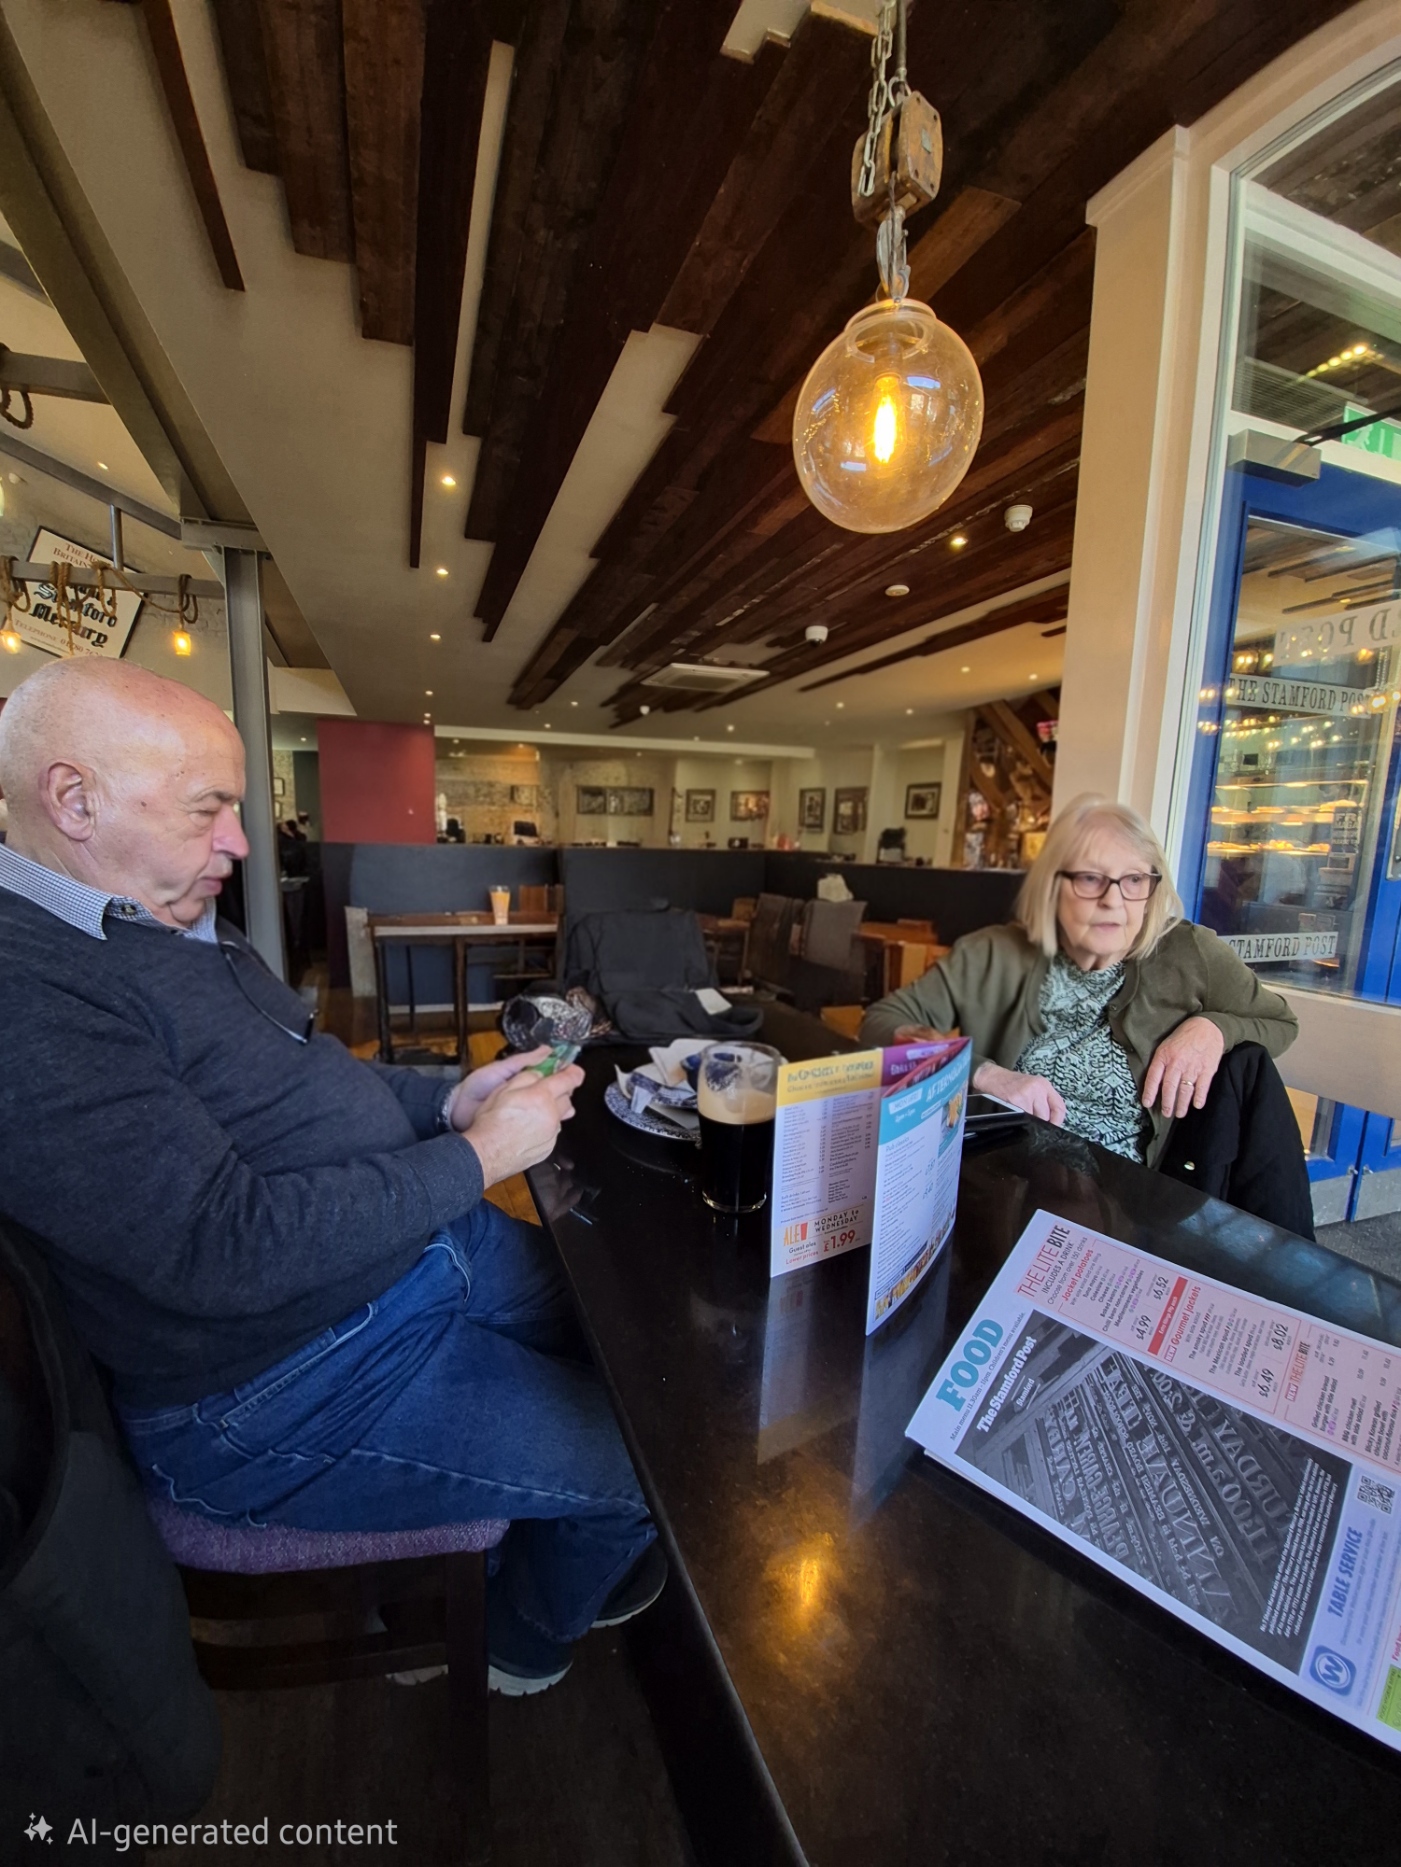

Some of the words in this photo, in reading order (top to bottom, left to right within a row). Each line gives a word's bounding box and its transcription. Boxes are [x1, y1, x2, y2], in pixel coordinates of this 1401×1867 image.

[33, 583, 117, 627] Stford
[29, 603, 109, 648] Meury
[1229, 677, 1257, 703] THE
[1262, 681, 1336, 711] STAMFORD
[1303, 935, 1336, 956] POST
[814, 1211, 847, 1227] MONDAY
[815, 1214, 857, 1233] WEDNESDAY
[783, 1223, 800, 1246] ALE
[788, 1243, 804, 1254] Guest
[823, 1228, 856, 1252] £1.99
[785, 1253, 802, 1265] Lower
[802, 1248, 818, 1260] prices
[1016, 1269, 1045, 1299] THE
[1031, 1244, 1059, 1273] LITE
[1045, 1224, 1071, 1248] BITE
[1046, 1283, 1063, 1305] Choose
[1057, 1270, 1069, 1285] from
[1064, 1260, 1075, 1272] over
[1075, 1235, 1088, 1252] drinks
[1040, 1264, 1062, 1294] INCLUDES
[1056, 1258, 1065, 1266] A
[1060, 1276, 1079, 1302] Jacket
[1072, 1247, 1095, 1278] potatoes
[1149, 1275, 1170, 1301] £6.52
[1089, 1280, 1104, 1301] Coleslaw
[1097, 1285, 1110, 1303] Cheese
[1099, 1301, 1111, 1318] Baked
[1106, 1287, 1118, 1303] beans
[1131, 1313, 1153, 1340] £4.99
[1169, 1311, 1191, 1346] Gourmet
[1182, 1284, 1203, 1313] jackets
[1268, 1321, 1290, 1351] £8.02
[1296, 1340, 1310, 1355] BITE
[934, 1314, 1007, 1412] FOOD
[1211, 1340, 1226, 1364] Mexican
[1293, 1352, 1307, 1369] LITE
[975, 1405, 998, 1434] The
[987, 1355, 1026, 1411] Stamford
[1015, 1334, 1037, 1361] Post
[1253, 1366, 1276, 1398] £6.49
[1289, 1366, 1303, 1383] THE
[1014, 1377, 1035, 1406] Stamford
[1314, 1390, 1326, 1411] chicken
[949, 1424, 961, 1440] Main
[958, 1409, 970, 1426] menu
[1367, 1416, 1378, 1437] Korean
[1336, 1525, 1363, 1579] SERVICE
[1326, 1574, 1351, 1620] TABLE
[1320, 1650, 1345, 1688] W
